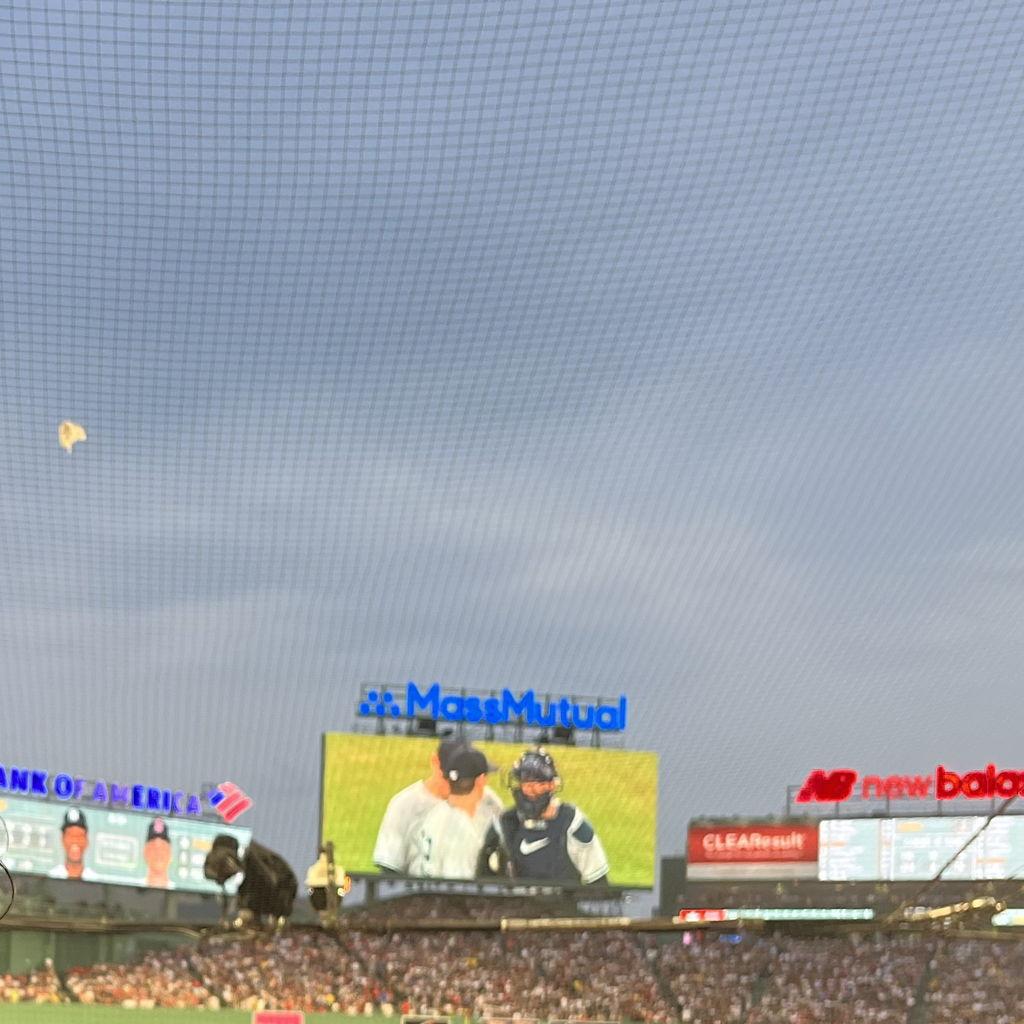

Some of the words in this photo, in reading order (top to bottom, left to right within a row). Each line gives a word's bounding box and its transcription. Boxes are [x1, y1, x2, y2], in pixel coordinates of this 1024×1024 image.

[406, 681, 628, 731] MassMutual
[54, 772, 84, 801] OF
[92, 779, 203, 816] AMERICA
[861, 774, 932, 799] new
[703, 831, 806, 852] CLEAResult
